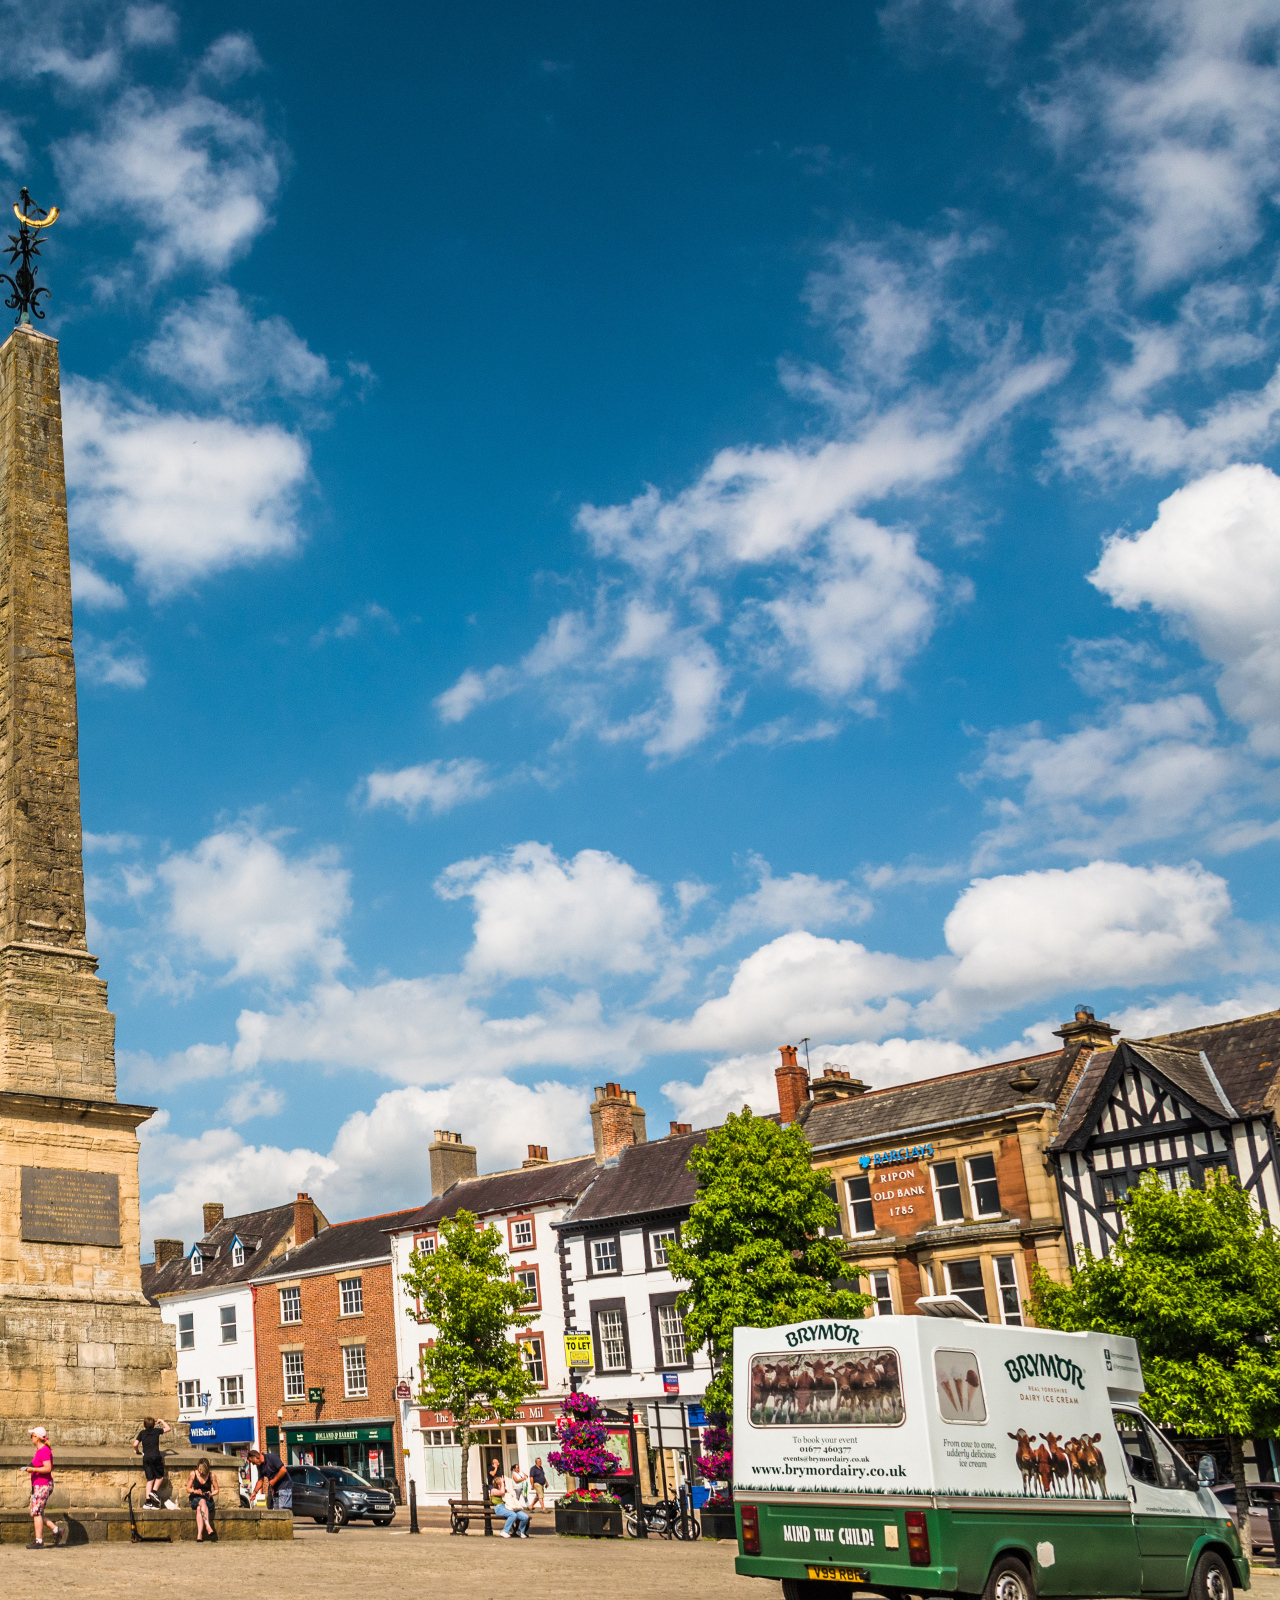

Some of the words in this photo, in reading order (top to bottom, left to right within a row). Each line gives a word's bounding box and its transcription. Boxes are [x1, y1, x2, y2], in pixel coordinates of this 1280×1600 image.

[873, 1143, 934, 1165] BARCLAYS
[880, 1169, 915, 1183] RIPON
[874, 1190, 895, 1202] OLD
[897, 1185, 925, 1198] BANK
[890, 1205, 914, 1216] 1785
[566, 1342, 576, 1350] TO
[578, 1342, 590, 1350] LET
[434, 1412, 449, 1423] The
[191, 1428, 216, 1437] WHSmith
[315, 1432, 334, 1440] HOLLAND
[338, 1431, 358, 1439] BARRETT
[821, 1437, 837, 1446] your
[943, 1438, 960, 1447] From
[800, 1446, 821, 1454] 01677
[823, 1446, 851, 1454] 460377
[946, 1448, 969, 1459] udderly
[971, 1450, 996, 1458] delicious
[959, 1459, 967, 1467] ice
[752, 1463, 907, 1479] www.brymordairy.co.uk
[783, 1525, 811, 1542] MIND
[814, 1528, 834, 1542] THAT
[839, 1528, 874, 1546] CHILD!
[814, 1567, 836, 1579] V99
